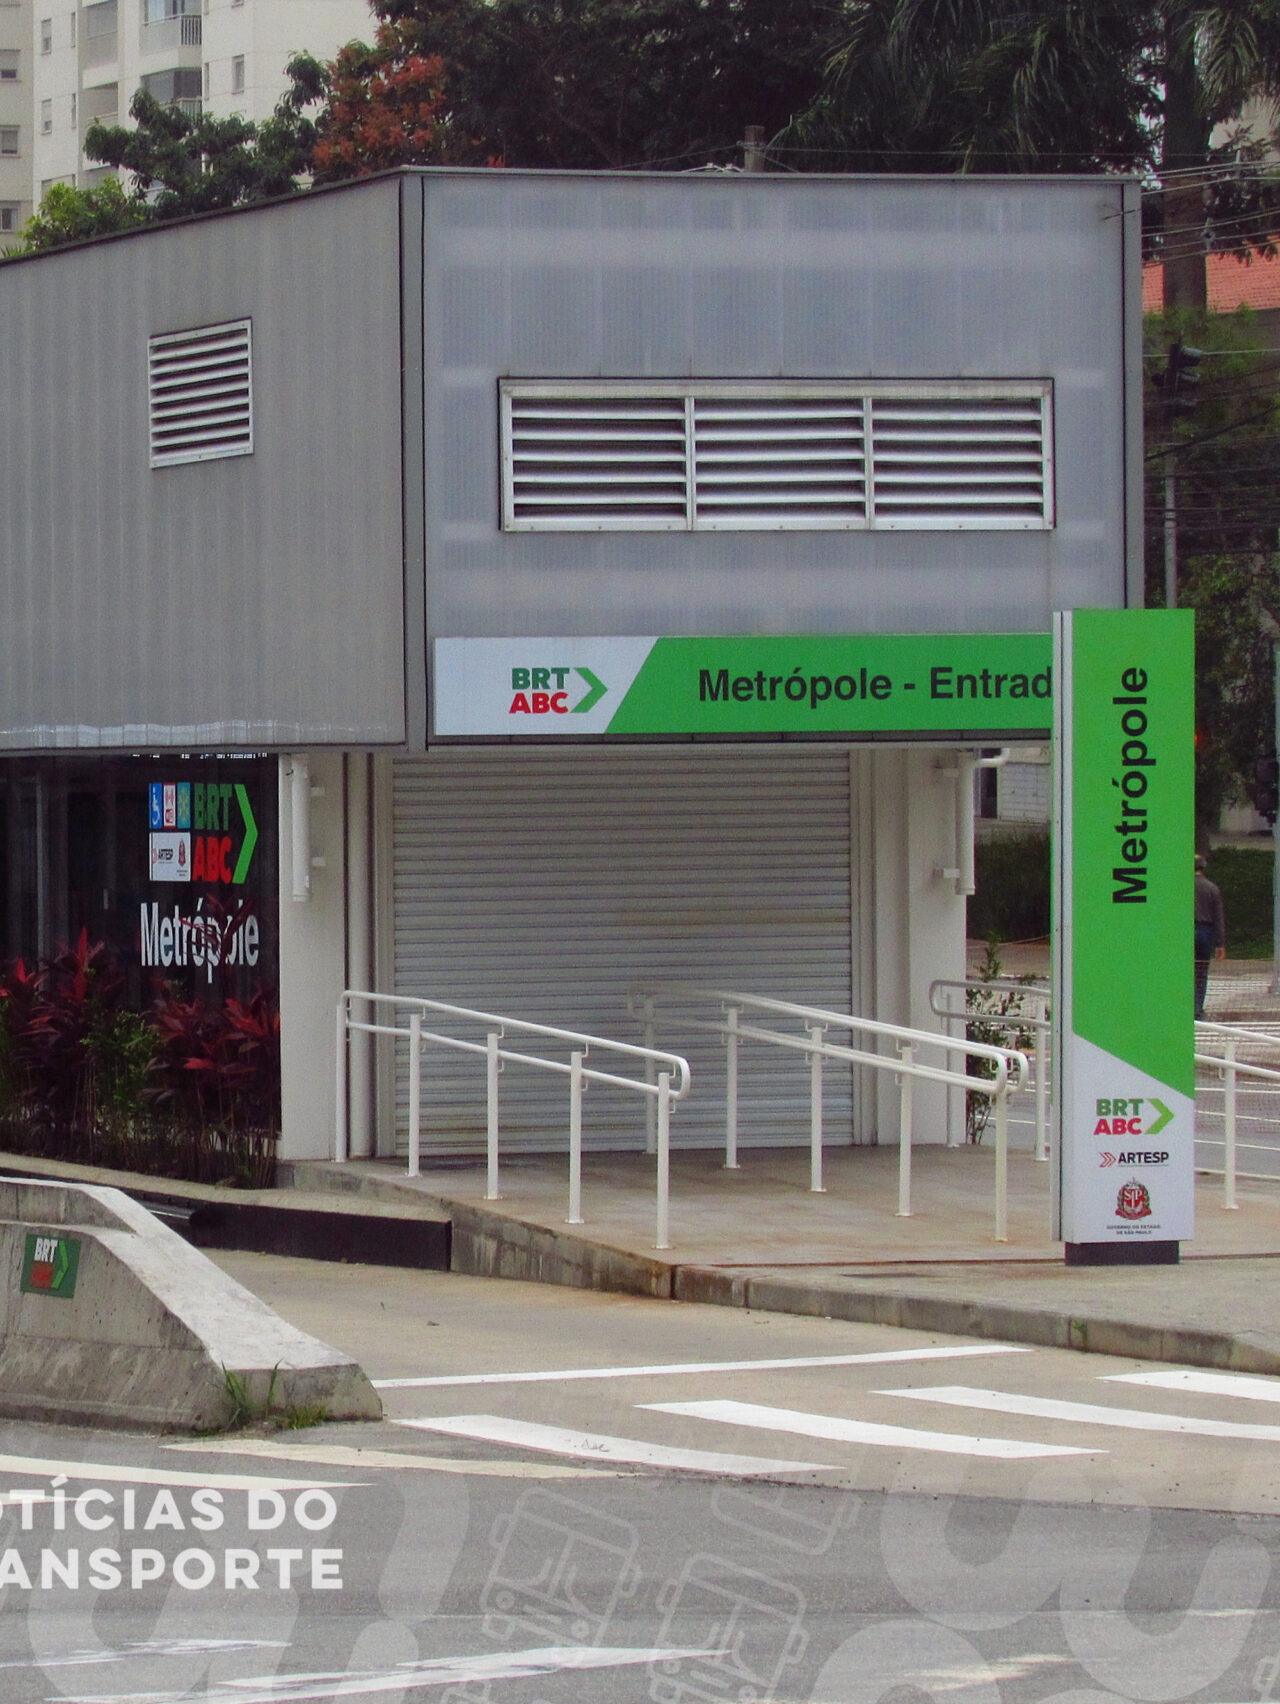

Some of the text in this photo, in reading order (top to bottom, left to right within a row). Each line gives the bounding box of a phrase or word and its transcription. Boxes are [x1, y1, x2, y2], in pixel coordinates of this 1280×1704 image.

[511, 666, 570, 690] BRT
[699, 667, 892, 709] Metrópole
[508, 691, 569, 714] ABC
[1111, 667, 1157, 904] Metrópole
[194, 782, 233, 831] BRT
[192, 835, 233, 884] ABC
[1096, 1098, 1144, 1117] BRT
[1093, 1117, 1142, 1136] ABC
[1117, 1151, 1169, 1164] ARTESP
[34, 1237, 59, 1263] BRT
